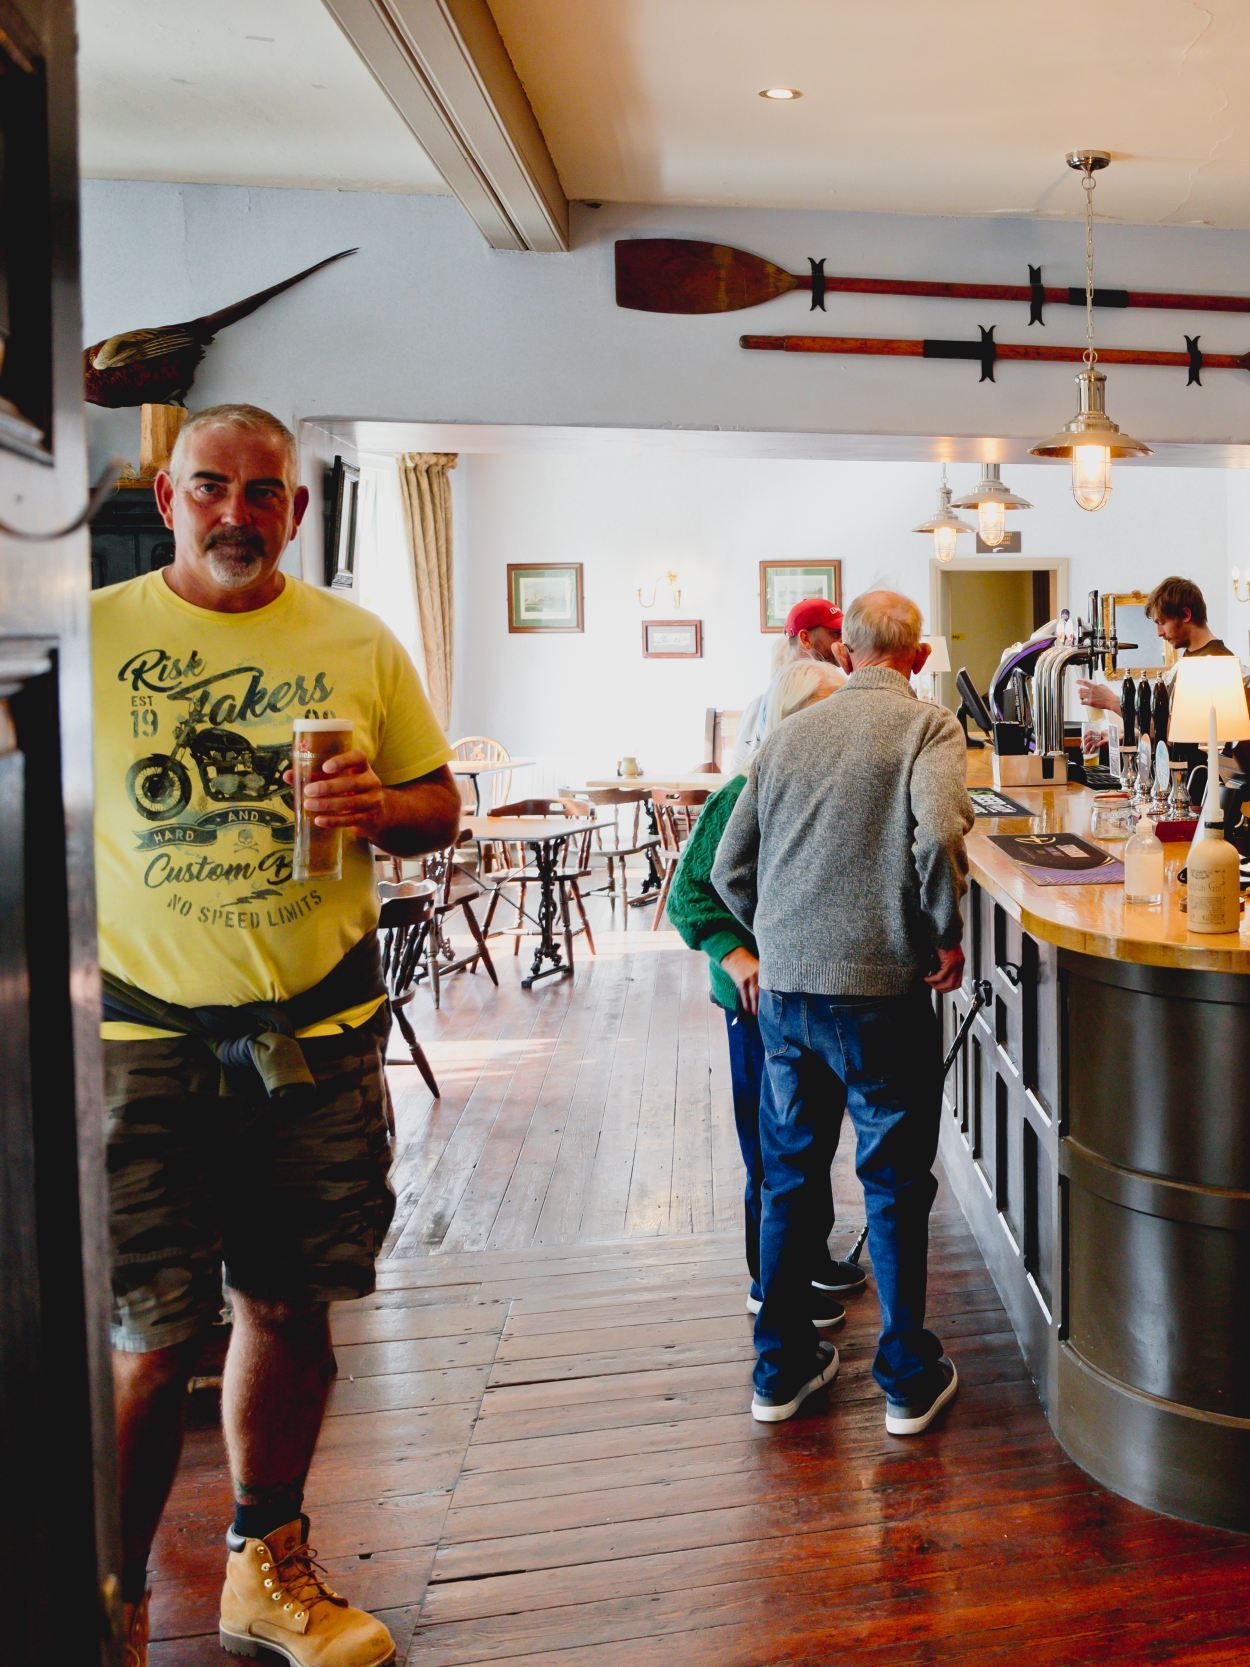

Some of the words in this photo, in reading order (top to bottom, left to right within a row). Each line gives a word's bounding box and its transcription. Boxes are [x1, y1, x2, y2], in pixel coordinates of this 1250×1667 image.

[117, 648, 205, 694] Risk
[131, 695, 154, 707] EST
[166, 666, 334, 727] Takers
[130, 709, 159, 739] 19
[153, 830, 195, 844] HARD
[227, 810, 260, 822] AND
[144, 852, 256, 889] Custom
[166, 893, 193, 916] NO
[197, 905, 260, 929] SPEED
[267, 889, 323, 928] LIMITS
